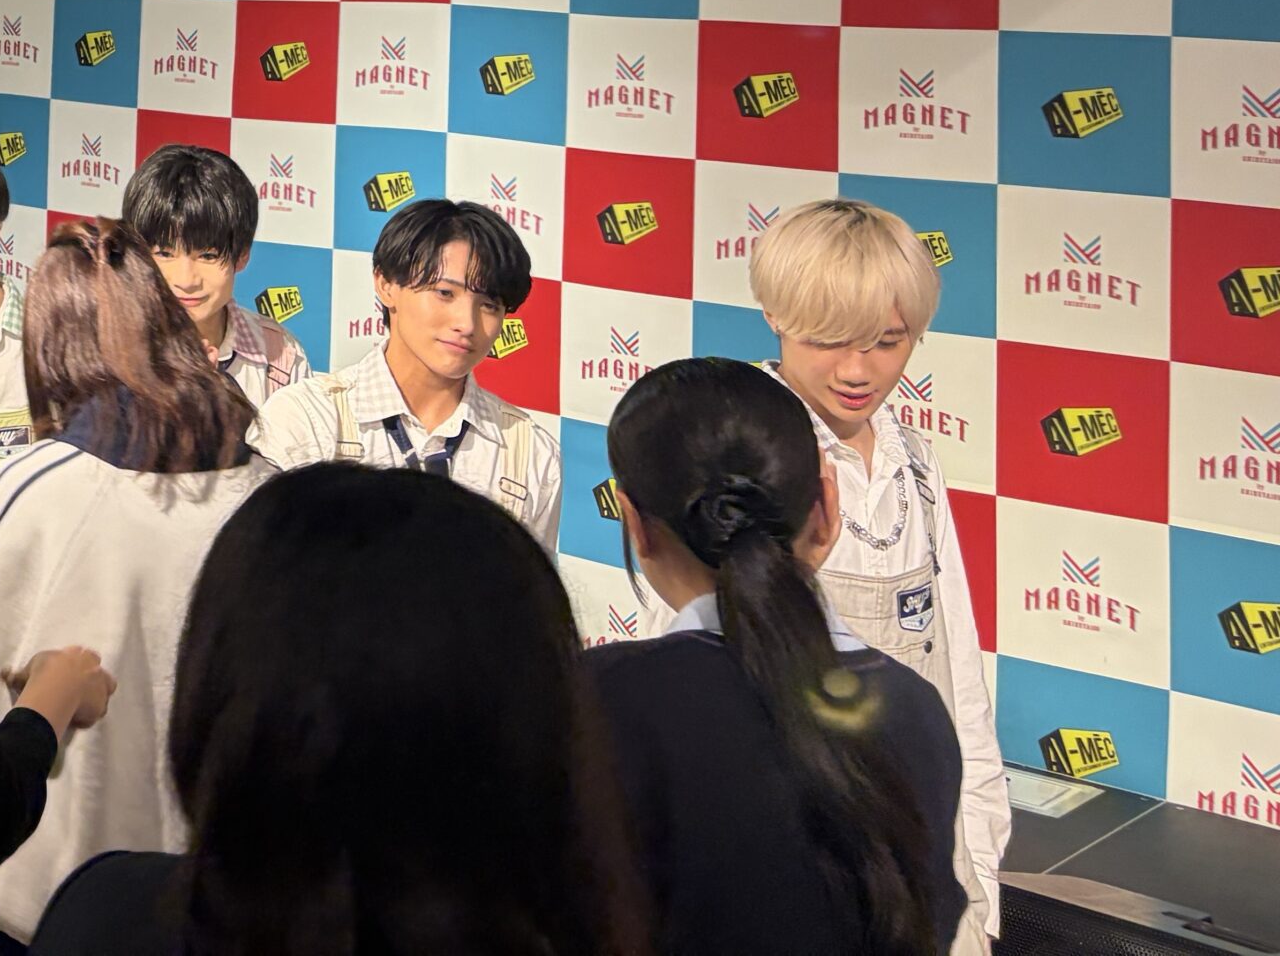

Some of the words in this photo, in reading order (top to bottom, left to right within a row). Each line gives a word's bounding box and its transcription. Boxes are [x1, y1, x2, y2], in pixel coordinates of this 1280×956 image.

[154, 55, 218, 80] MAGNET
[355, 65, 430, 91] MAGNET
[587, 86, 674, 115] MAGNET
[864, 103, 971, 134] MAGNET
[1201, 123, 1280, 151] MAGN
[62, 159, 120, 185] MAGNET
[258, 181, 317, 208] AGNET
[1024, 269, 1141, 306] MAGNET
[582, 358, 654, 381] MAGN
[900, 404, 969, 443] GNET
[1199, 455, 1280, 486] MAGN
[1024, 587, 1140, 632] MAGNET
[1197, 790, 1280, 827] MAGN
